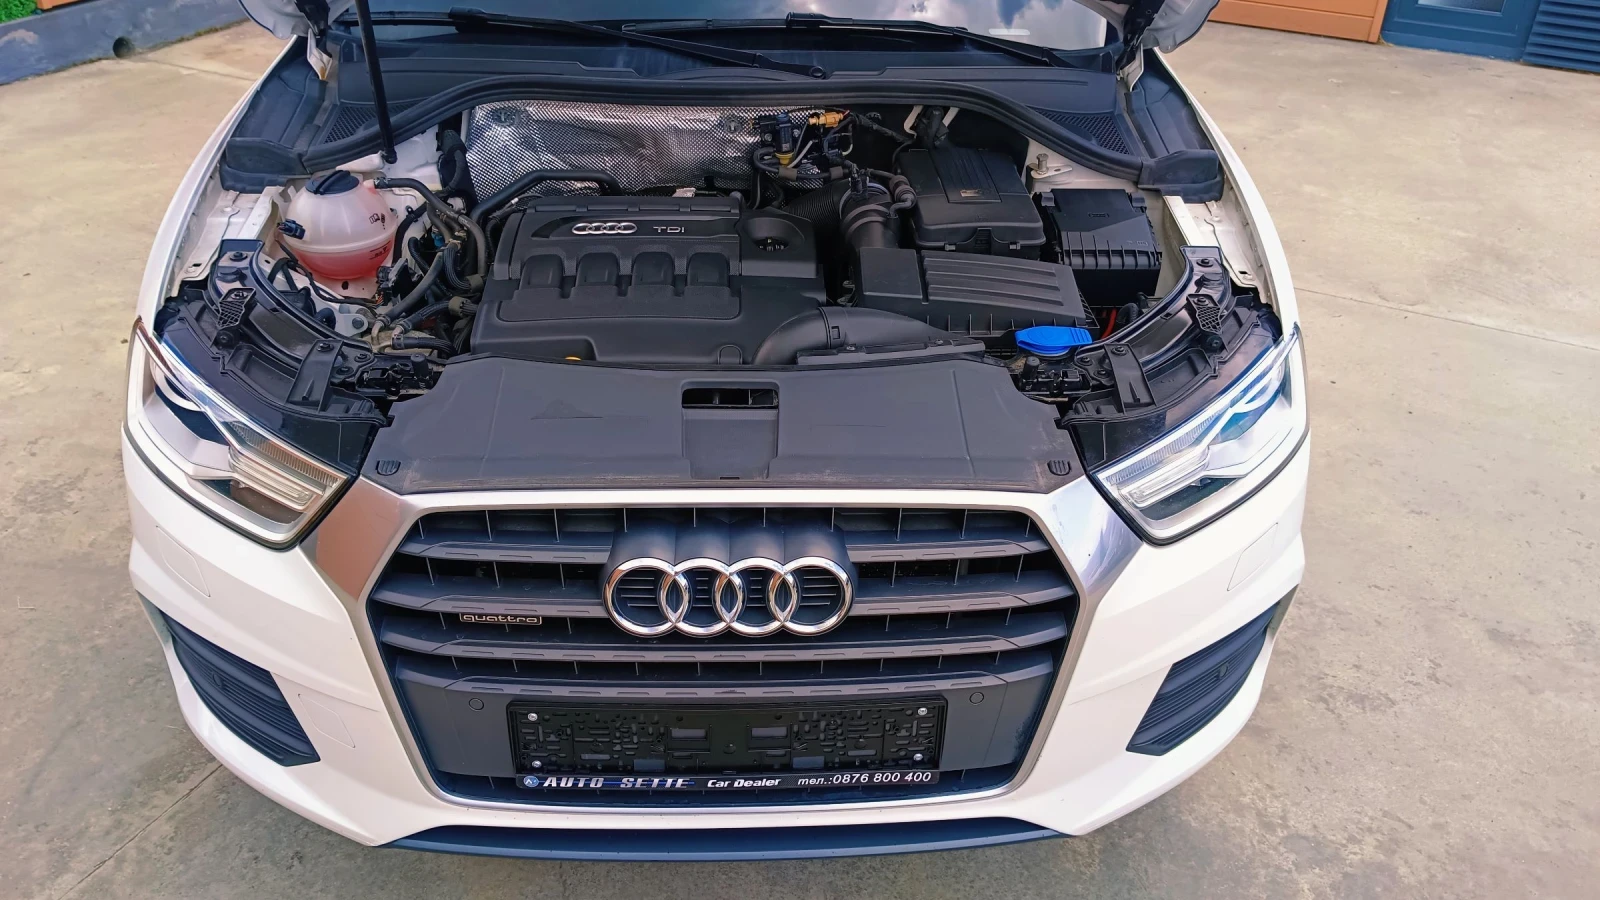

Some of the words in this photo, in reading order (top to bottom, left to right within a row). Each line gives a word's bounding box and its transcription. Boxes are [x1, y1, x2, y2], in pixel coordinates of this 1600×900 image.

[463, 614, 538, 623] quattro
[542, 776, 605, 788] AUTO
[619, 777, 691, 788] SETTE
[707, 778, 729, 788] Car
[733, 777, 782, 788] Dealer
[873, 772, 901, 783] 800
[904, 771, 932, 783] 400
